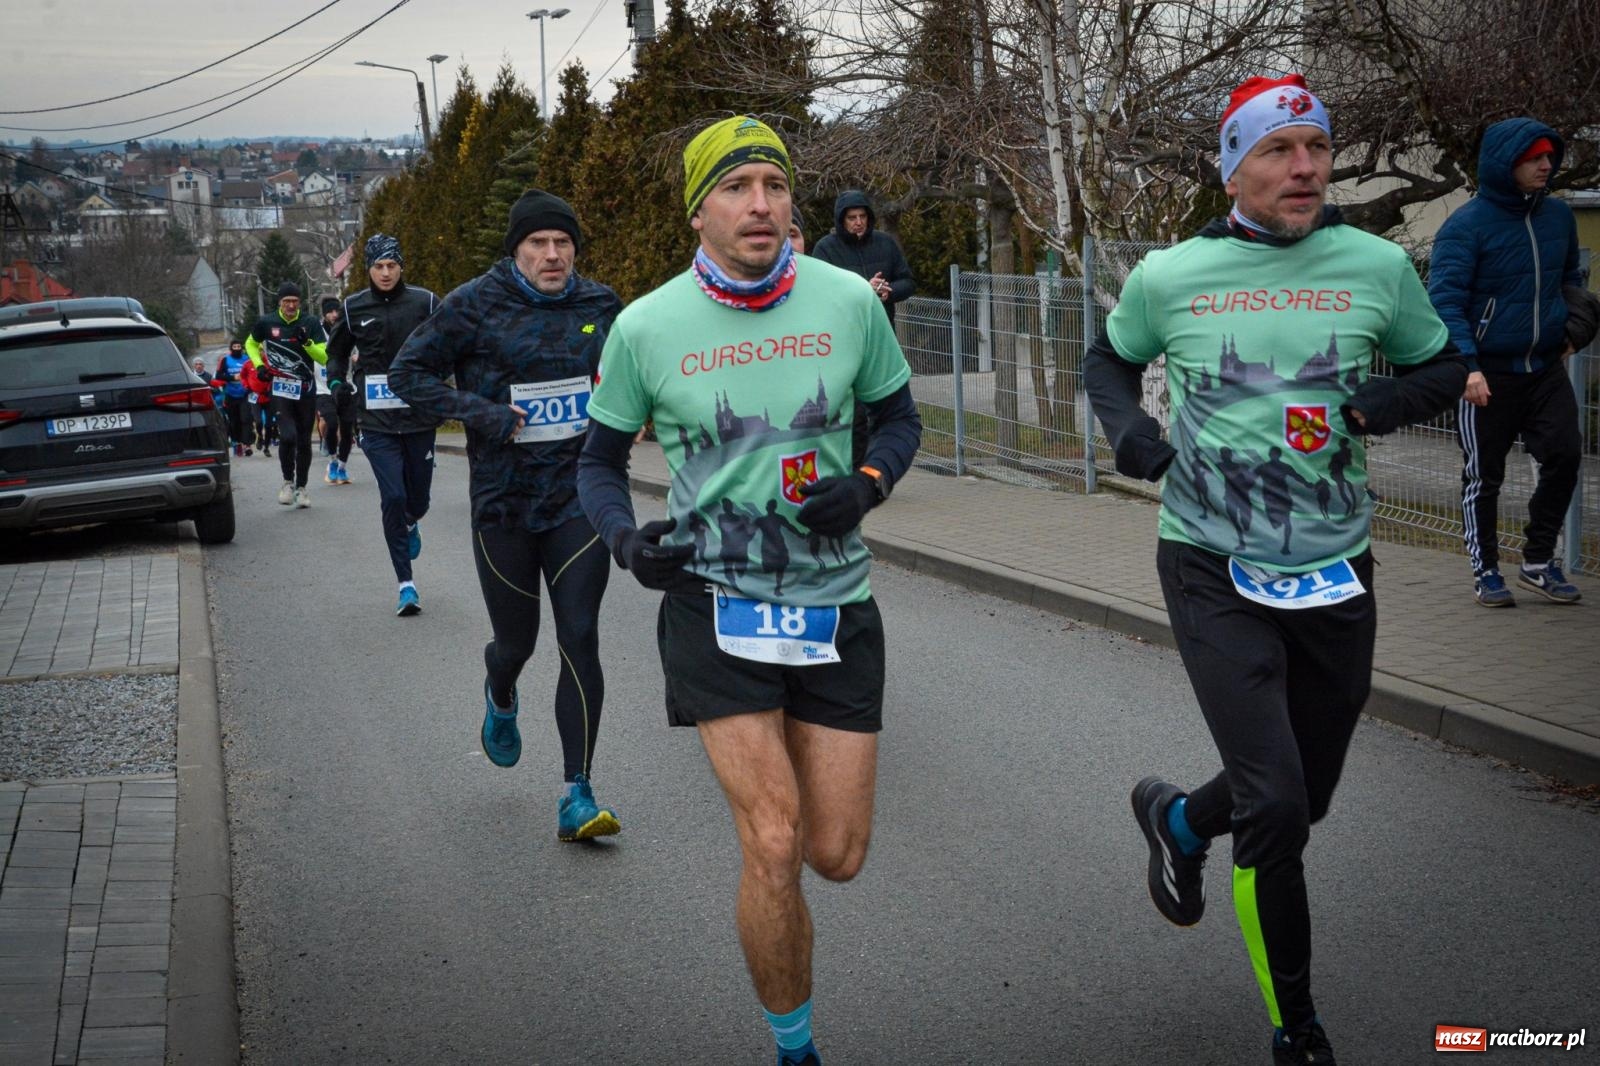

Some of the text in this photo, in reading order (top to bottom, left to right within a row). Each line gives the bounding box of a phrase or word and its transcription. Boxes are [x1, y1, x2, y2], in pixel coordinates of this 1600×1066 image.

[1190, 289, 1353, 316] CURSORES
[582, 324, 595, 334] 4F
[680, 332, 832, 376] CURSORES
[278, 383, 297, 395] 120
[374, 384, 395, 399] 13
[528, 395, 581, 424] 201
[56, 414, 127, 434] OP 1239P
[75, 443, 114, 453] Ateca
[1248, 570, 1334, 598] 191
[753, 602, 806, 637] 18
